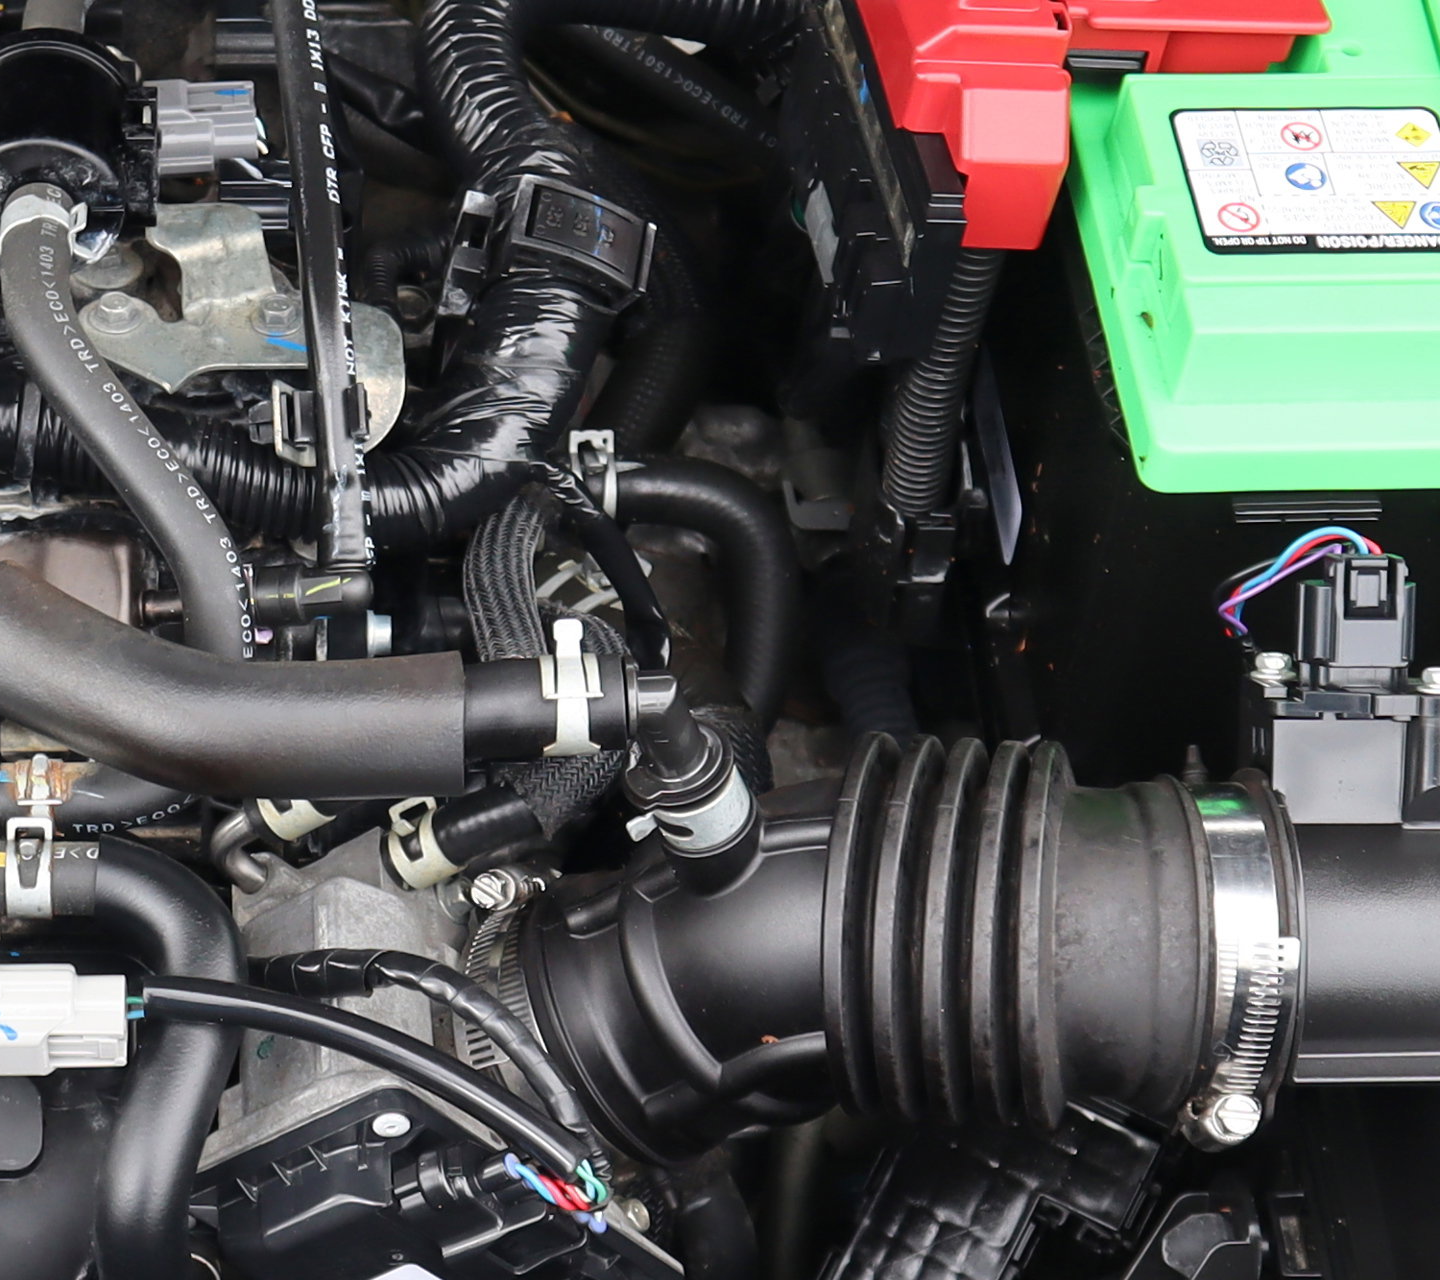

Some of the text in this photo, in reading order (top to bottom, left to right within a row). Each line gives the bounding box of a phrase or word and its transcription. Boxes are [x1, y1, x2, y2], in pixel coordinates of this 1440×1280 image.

[319, 123, 337, 160] CFP
[326, 166, 341, 204] DTR
[1241, 236, 1255, 246] OR
[1256, 235, 1270, 245] TIP
[1273, 235, 1291, 245] NOT
[1293, 235, 1307, 245] DO
[343, 338, 356, 376] NOT
